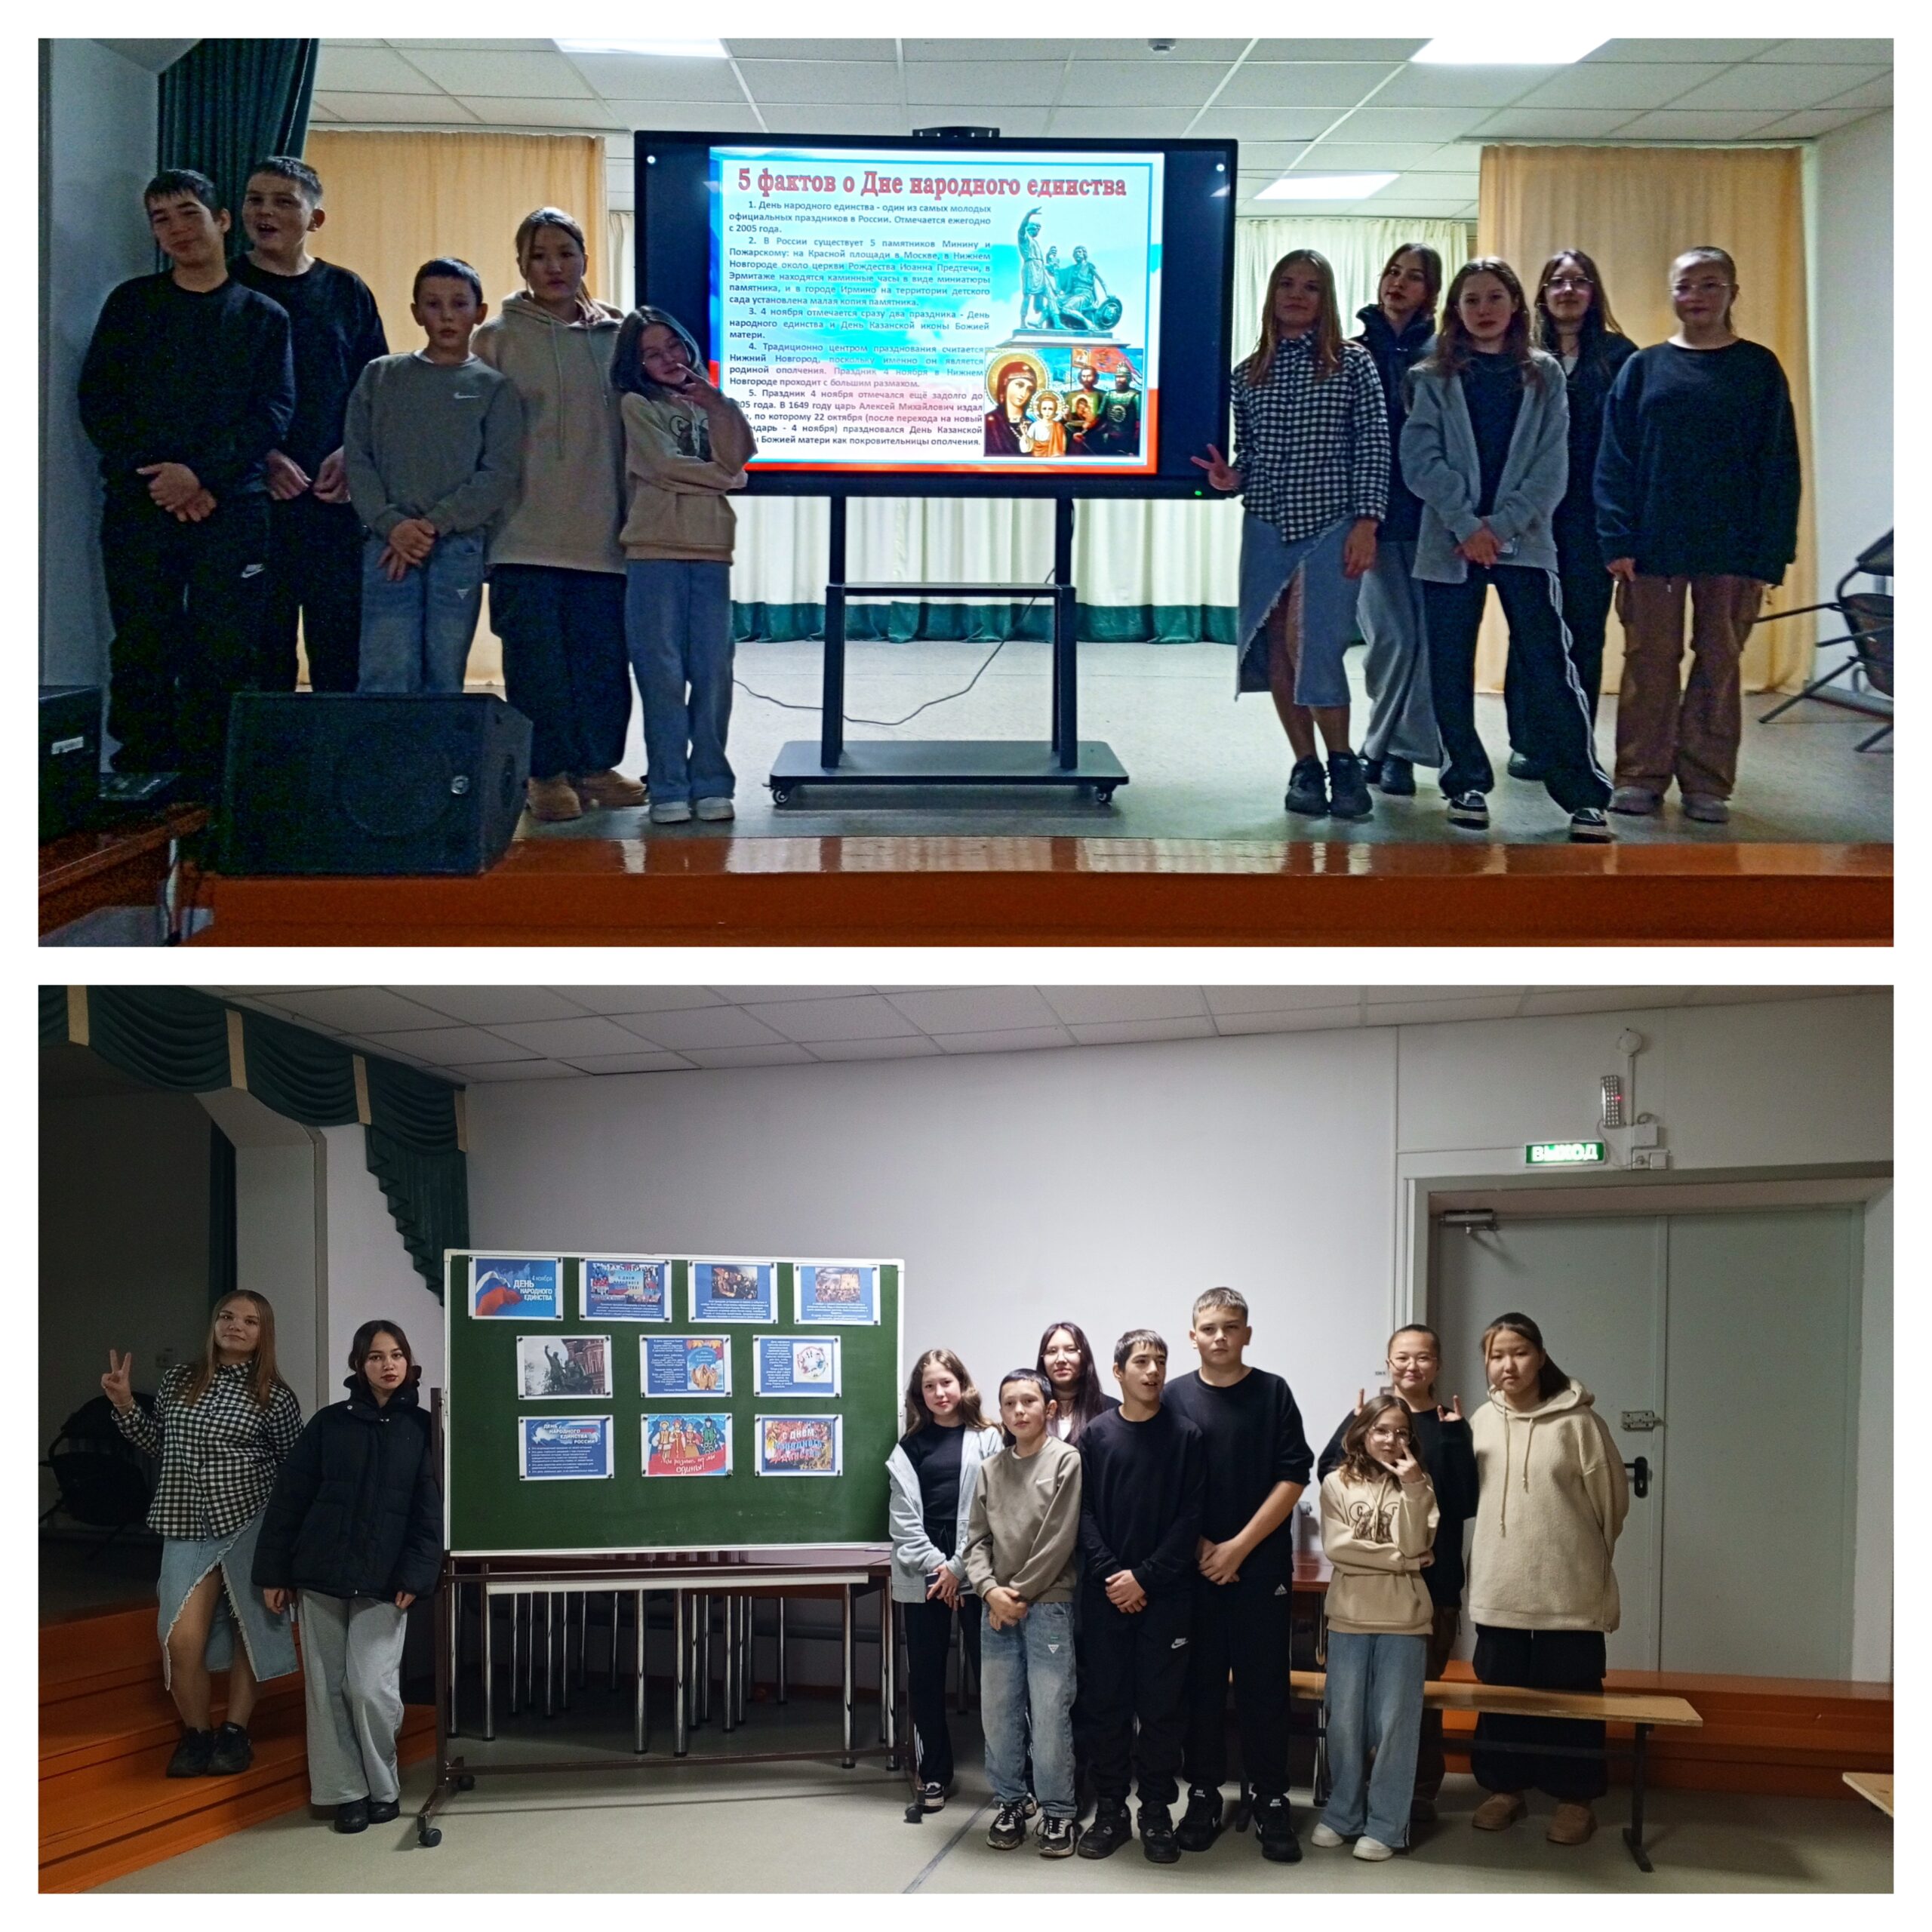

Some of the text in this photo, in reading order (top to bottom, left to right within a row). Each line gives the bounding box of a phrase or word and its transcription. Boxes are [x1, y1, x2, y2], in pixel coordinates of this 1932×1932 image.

[738, 168, 1127, 201] 5 фактов о Дне народного единства
[758, 201, 781, 210] День
[783, 203, 832, 211] народного
[729, 212, 792, 223] официальных
[776, 237, 807, 245] России
[942, 240, 979, 250] Минину
[729, 248, 789, 258] Пожарскому:
[808, 250, 845, 260] Красной
[904, 251, 940, 260] Москве,
[954, 251, 990, 260] Нижнем
[730, 260, 777, 270] Новгороде
[848, 262, 895, 271] Рождества
[900, 263, 933, 271] Иоанна
[937, 263, 981, 273] Предтечи,
[729, 272, 775, 281] Эрмитаже
[937, 277, 990, 285] миниатюры
[805, 286, 836, 294] городе
[841, 285, 876, 295] Ирмино
[897, 288, 947, 296] территории
[752, 297, 808, 306] установлена
[771, 307, 803, 317] ноября
[861, 310, 885, 318] сразу
[909, 312, 955, 320] праздника
[967, 311, 989, 320] День
[730, 321, 777, 329] народного
[841, 321, 864, 329] День
[869, 321, 915, 329] Казанской
[730, 332, 765, 340] матери.
[763, 343, 823, 352] Традиционно
[730, 354, 766, 362] Нижний
[776, 355, 820, 365] Новгород,
[730, 365, 768, 375] родиной
[834, 367, 876, 377] Праздник
[896, 368, 928, 377] ноября
[729, 377, 777, 387] Новгороде
[779, 380, 820, 388] проходит
[749, 389, 756, 397] 5.
[762, 389, 805, 399] Праздник
[820, 390, 854, 399] ноября
[909, 391, 927, 400] ещё
[812, 403, 832, 411] году
[898, 402, 954, 411] Михайлович
[826, 413, 863, 423] октября
[865, 414, 894, 423] (после
[953, 414, 984, 423] новый
[801, 424, 838, 434] ноября)
[909, 426, 932, 434] День
[937, 426, 982, 434] Казанской
[761, 435, 795, 444] Божией
[850, 438, 930, 447] покровительницы
[1531, 1143, 1598, 1161] ВЫХОД
[513, 1280, 534, 1289] ДЕНЬ
